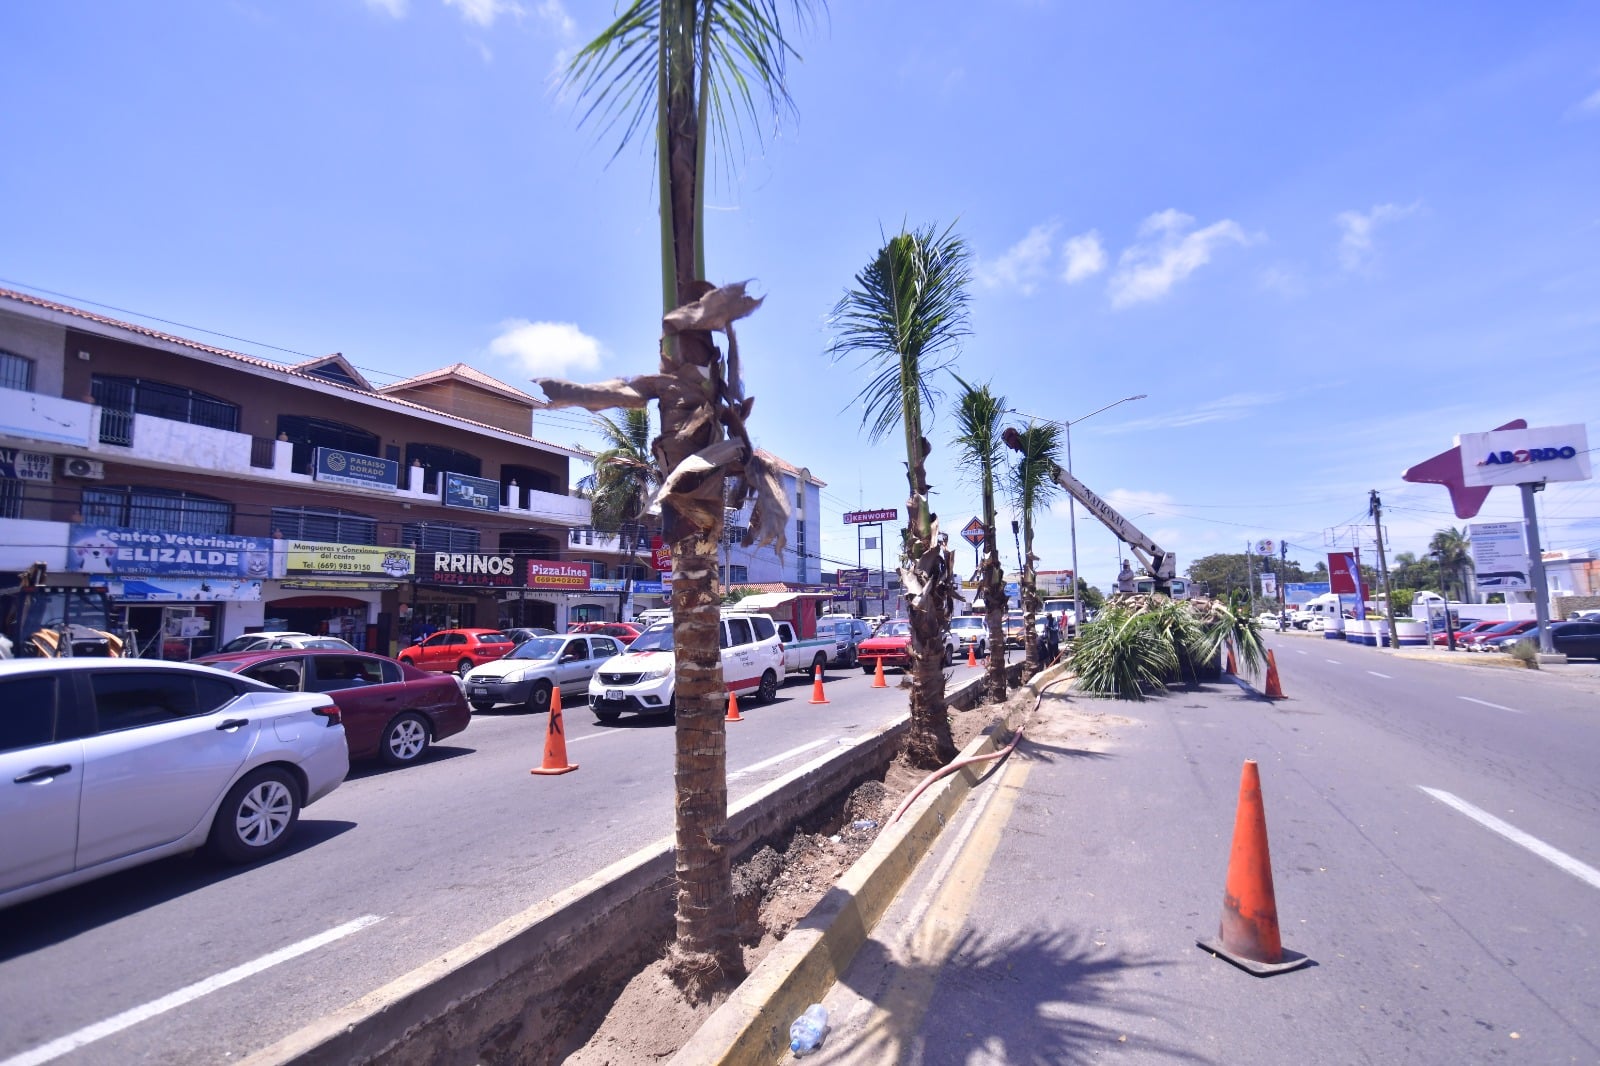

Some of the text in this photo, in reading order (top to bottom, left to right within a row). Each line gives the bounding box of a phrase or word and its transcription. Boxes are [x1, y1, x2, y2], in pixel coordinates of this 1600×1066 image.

[350, 457, 386, 469] PARAISO
[1485, 445, 1576, 465] ABORDO
[350, 465, 384, 476] DORADO
[1084, 488, 1125, 527] NATIONAL
[853, 511, 896, 521] KENWORTH
[96, 529, 257, 551] Centro Veterinario
[293, 543, 335, 552] Mangueras
[117, 547, 239, 566] ELIZALDE
[434, 551, 515, 576] RRINOS
[317, 561, 337, 569] (669)
[338, 562, 351, 570] 983
[532, 564, 588, 577] Pizza Línea
[549, 708, 562, 736] K
